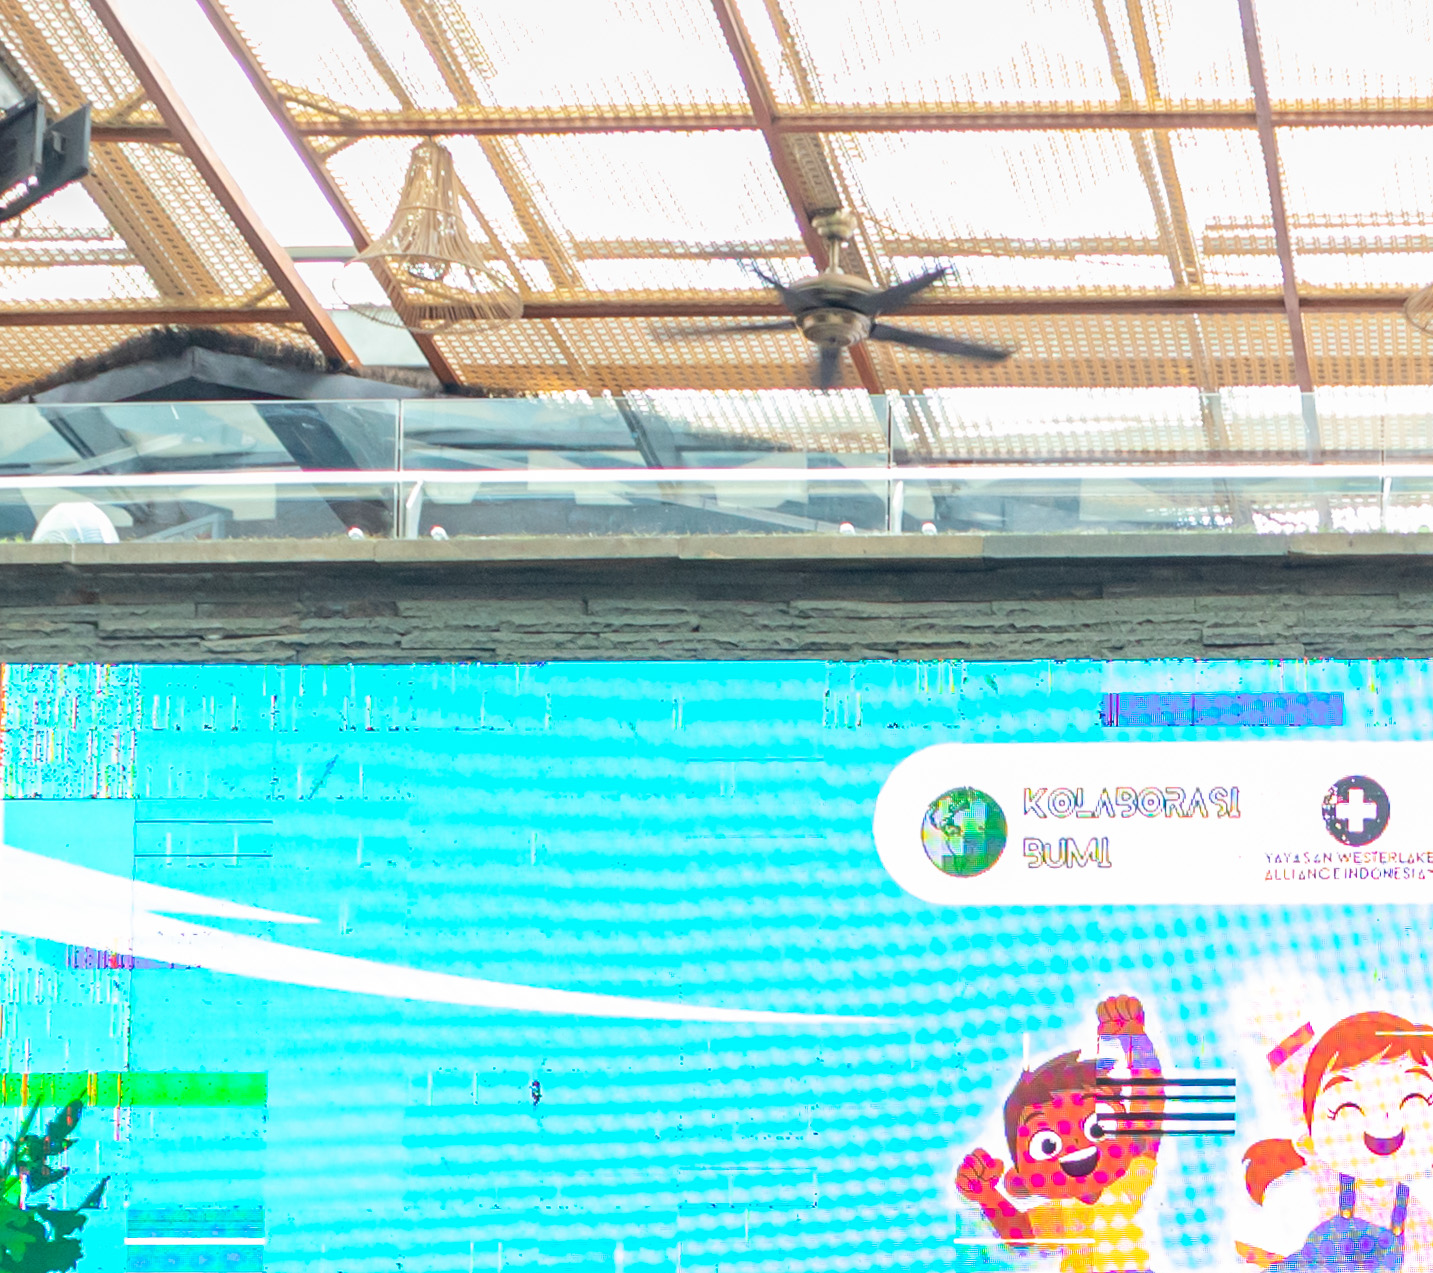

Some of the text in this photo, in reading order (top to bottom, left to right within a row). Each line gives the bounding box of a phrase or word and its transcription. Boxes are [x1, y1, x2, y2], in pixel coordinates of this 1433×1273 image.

[1023, 787, 1241, 818] KOLABORASI
[1023, 838, 1112, 868] BUMI
[1265, 852, 1333, 864] YAYASAN
[1265, 867, 1426, 880] ALLIANCE INDONESIA
